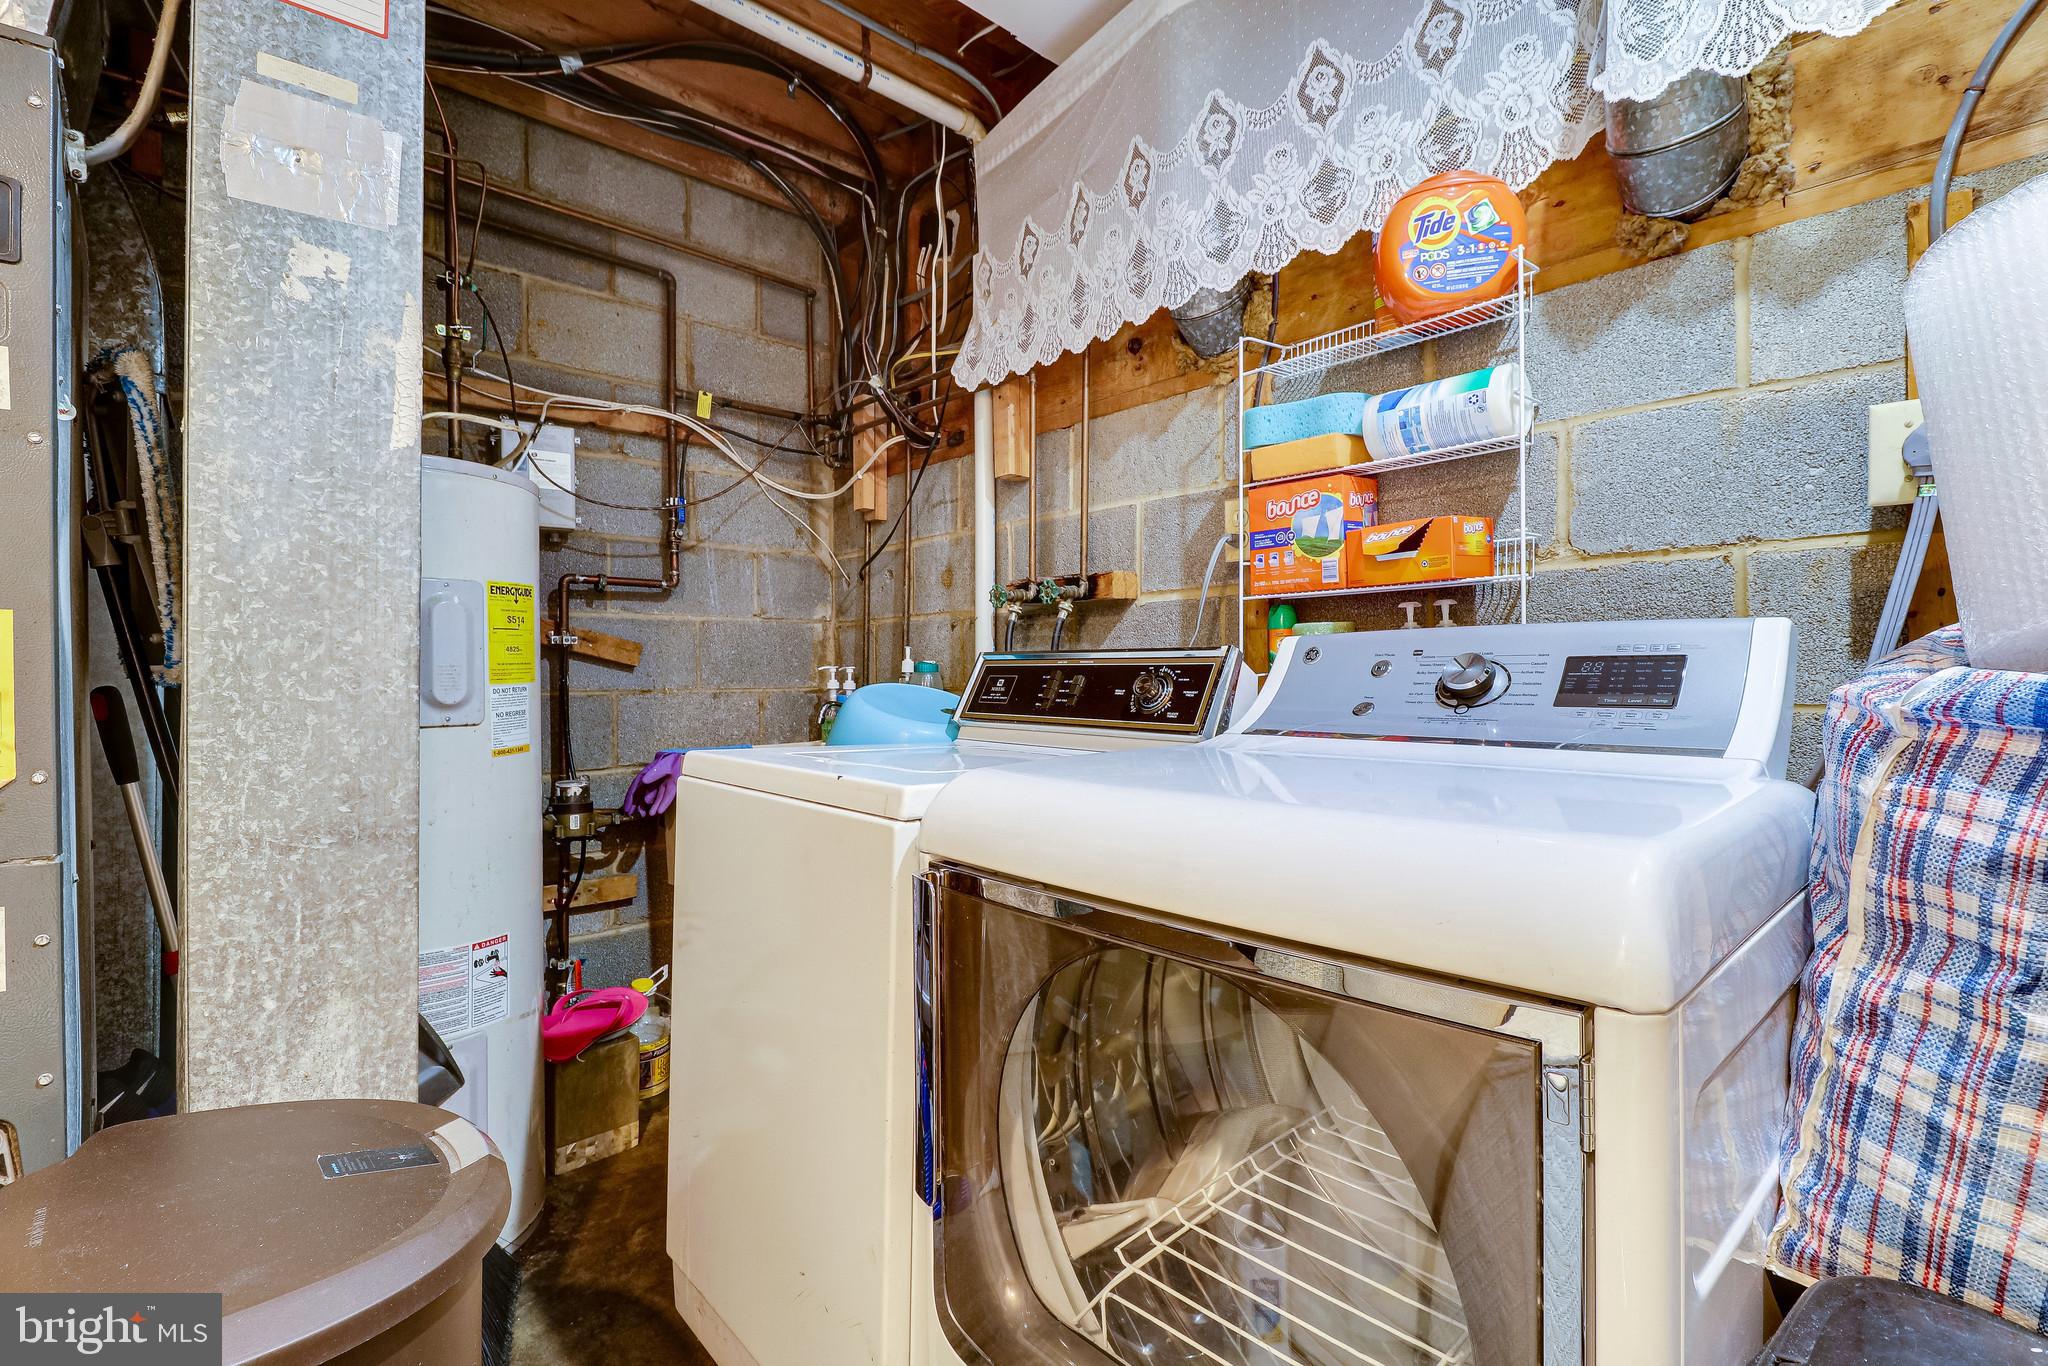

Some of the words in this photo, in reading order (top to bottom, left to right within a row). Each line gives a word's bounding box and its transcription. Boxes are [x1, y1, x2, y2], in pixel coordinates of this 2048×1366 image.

[1413, 210, 1456, 245] Tide
[1420, 250, 1450, 262] PODS
[1267, 491, 1320, 519] bounce
[1350, 491, 1374, 508] bounce
[1367, 525, 1415, 543] bounce
[1464, 521, 1484, 534] bounce
[507, 616, 525, 624] $514
[481, 936, 507, 948] DANGER
